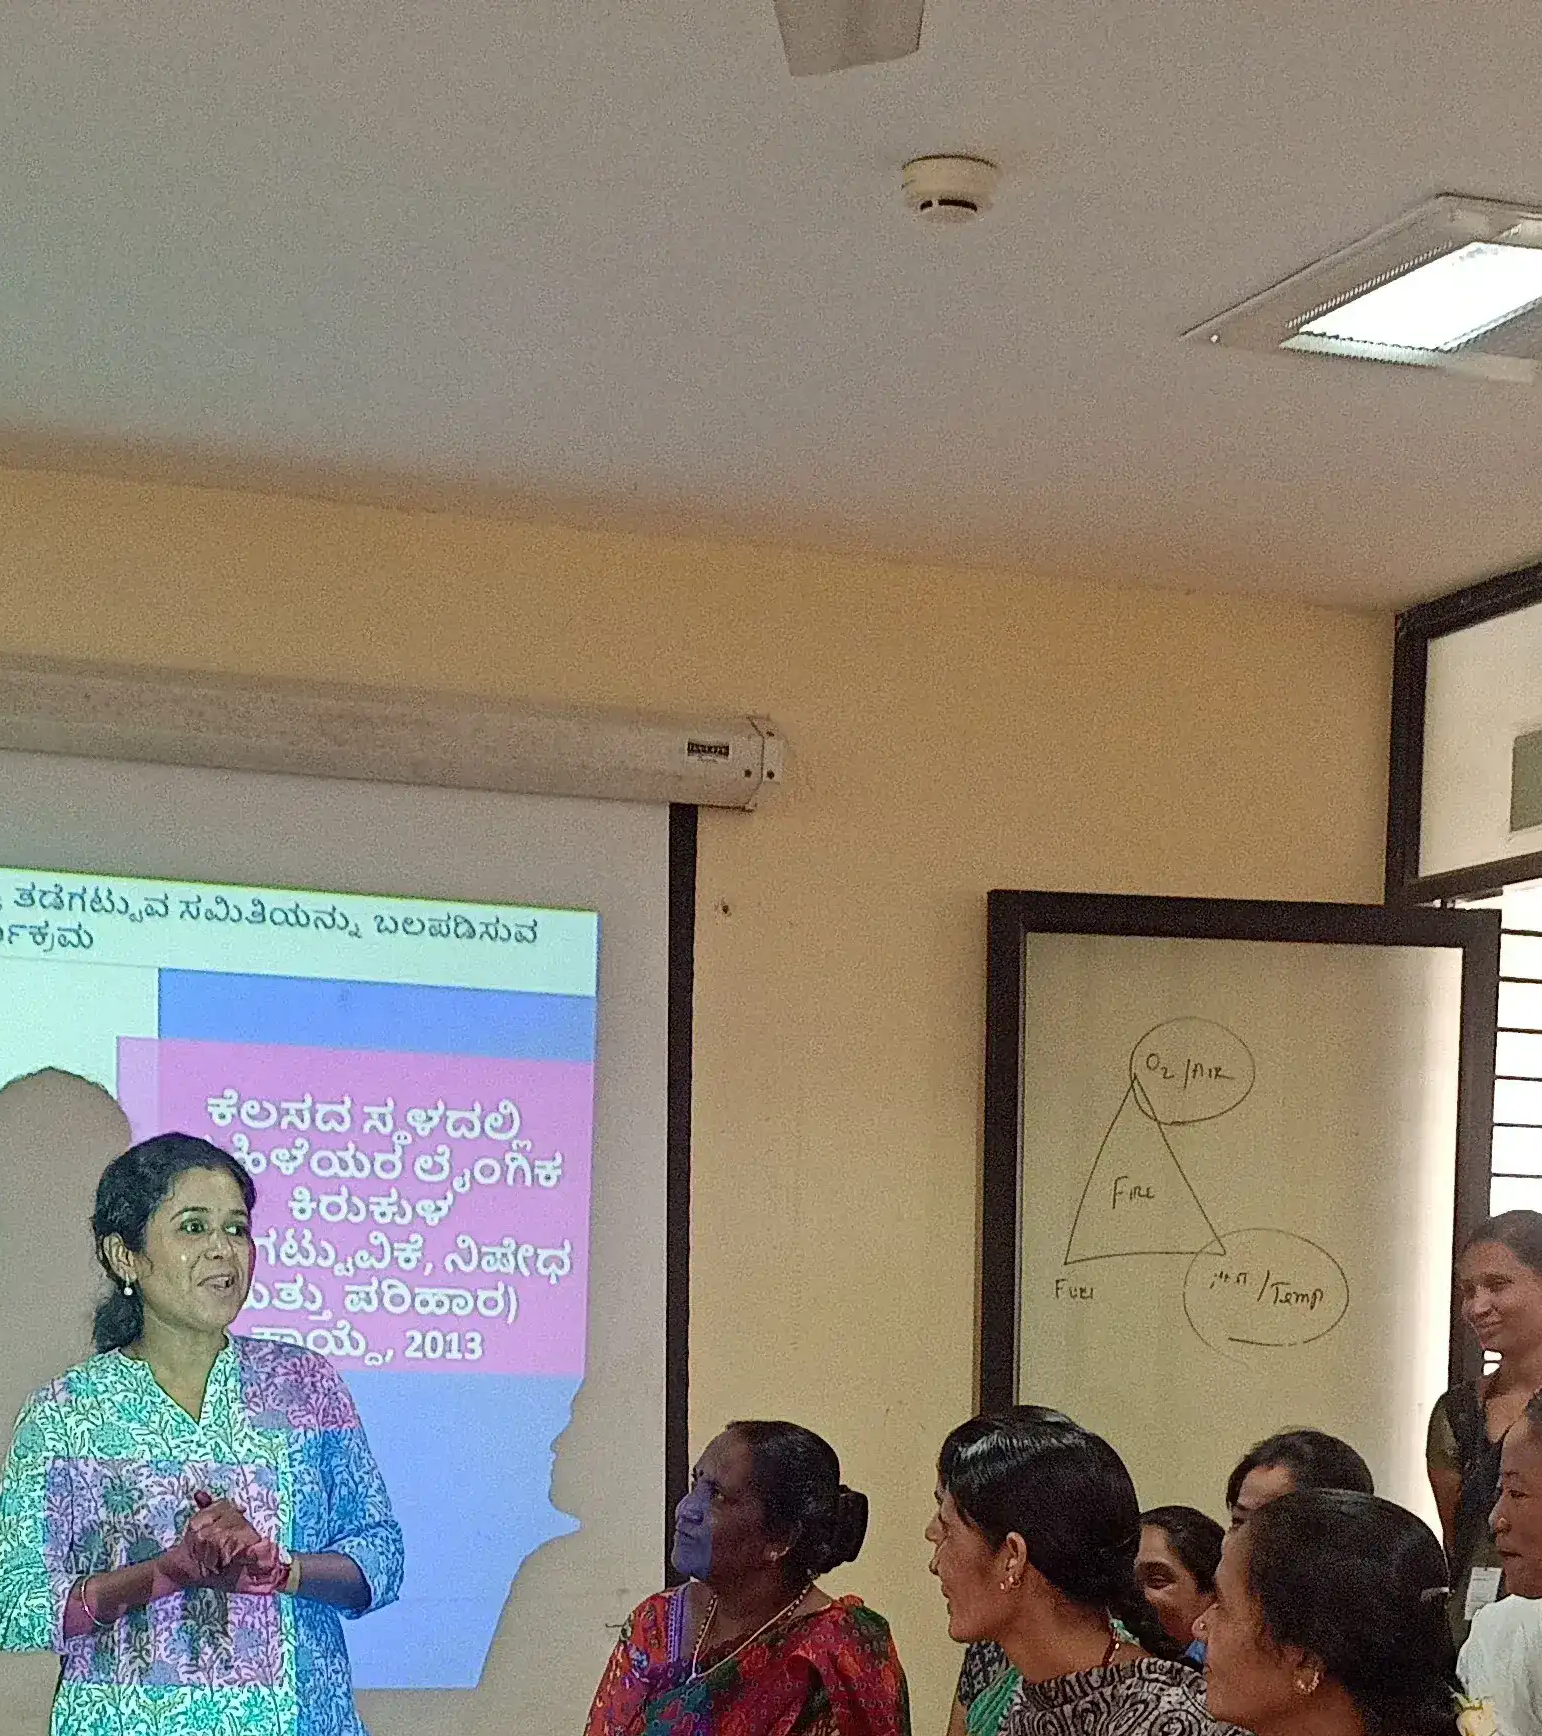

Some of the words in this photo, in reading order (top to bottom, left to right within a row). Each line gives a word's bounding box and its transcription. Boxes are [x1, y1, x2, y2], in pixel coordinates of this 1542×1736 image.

[13, 884, 169, 923] ತಡೆಗಟ್ಟುವ
[180, 893, 363, 938] ಸಮಿತಿಯನ್ನು
[373, 912, 539, 945] ಬಲಪಡಿಸುವ
[207, 1088, 352, 1133] ಕೆಲಸದ
[362, 1096, 533, 1152] ಸ್ಥಳದಲ್ಲಿ
[231, 1132, 403, 1180] ಹಿಳೆಯರ
[413, 1145, 563, 1193] ಲೈಂಗಿಕ
[288, 1186, 455, 1225] ಕಿರುಕುಳ
[254, 1228, 434, 1277] ಗಟ್ಟುವಿಕೆ,
[444, 1235, 572, 1284] ನಿಷೇಧ
[344, 1276, 519, 1324] ಪರಿಹಾರ)
[404, 1330, 483, 1360] 2013
